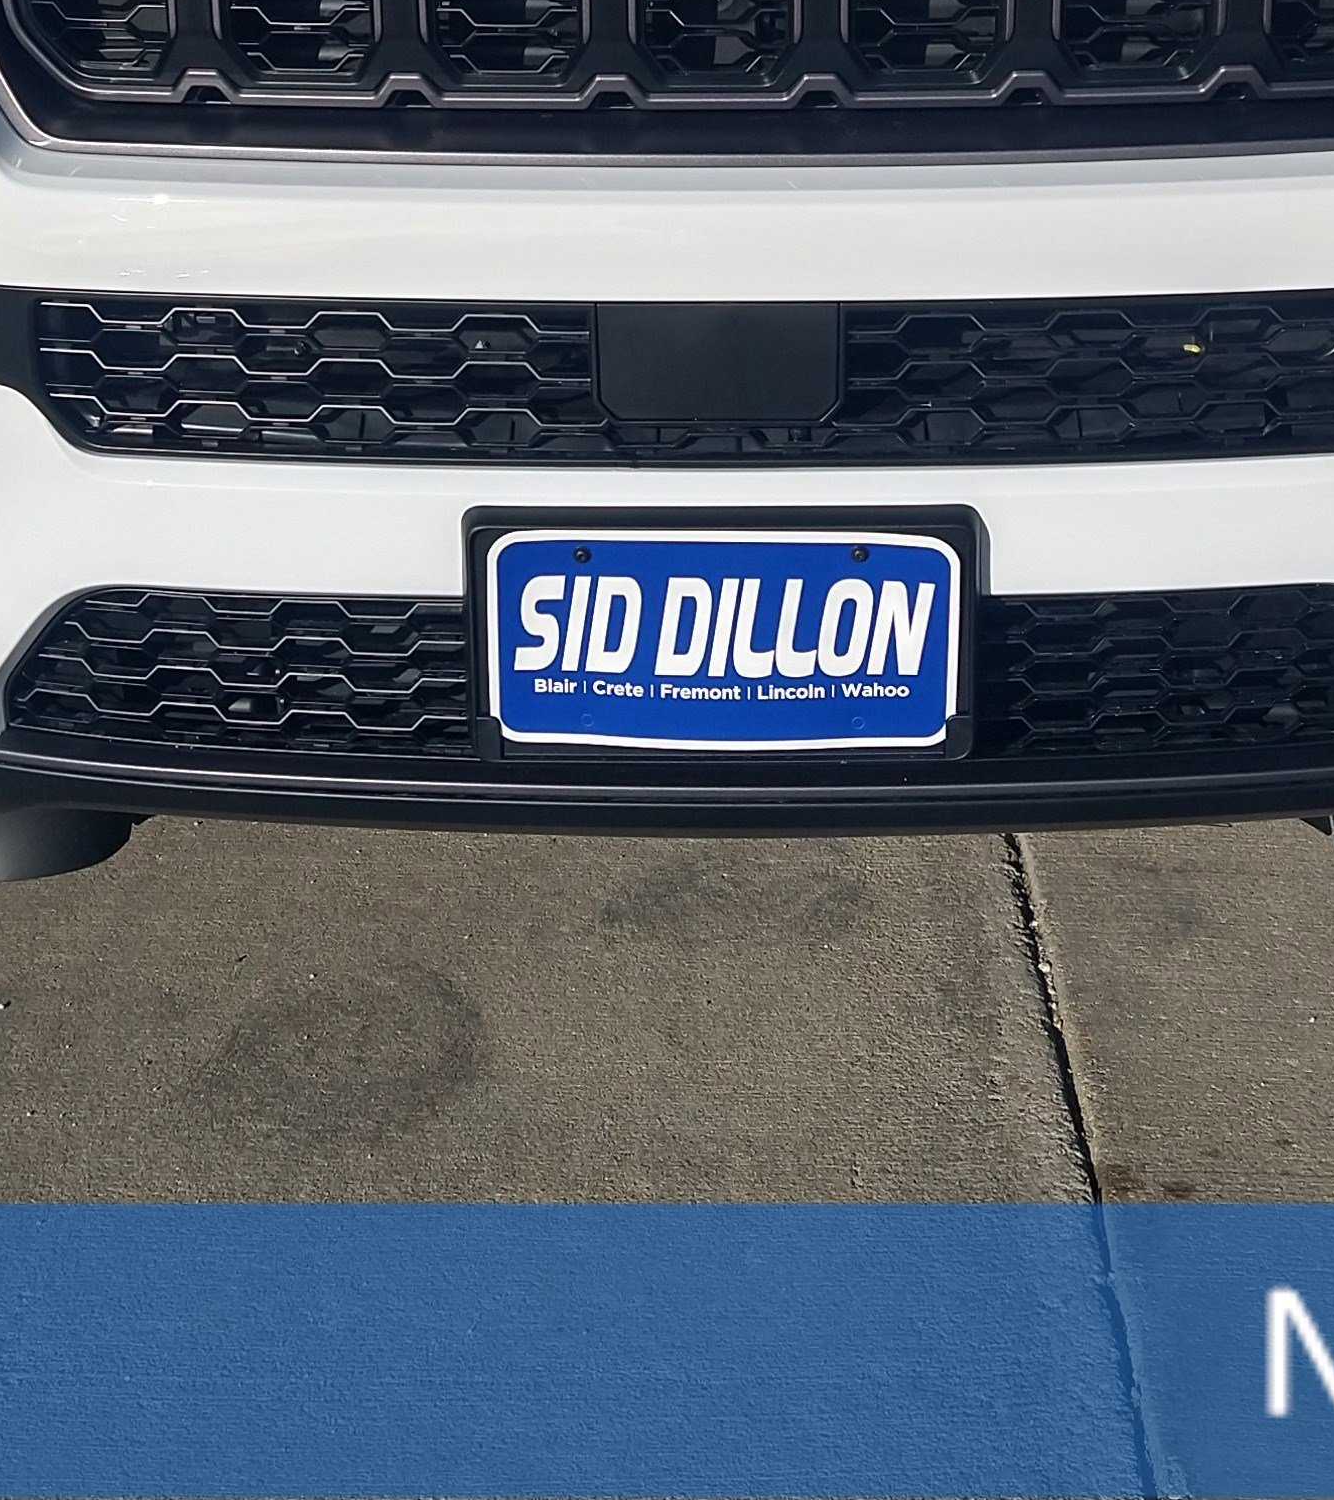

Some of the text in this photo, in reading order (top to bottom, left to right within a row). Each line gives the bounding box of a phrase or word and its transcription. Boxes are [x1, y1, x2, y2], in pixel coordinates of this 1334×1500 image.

[513, 574, 936, 679] SID DILLON
[534, 678, 910, 700] Blair Crete Fremont Lincoln Wahoo
